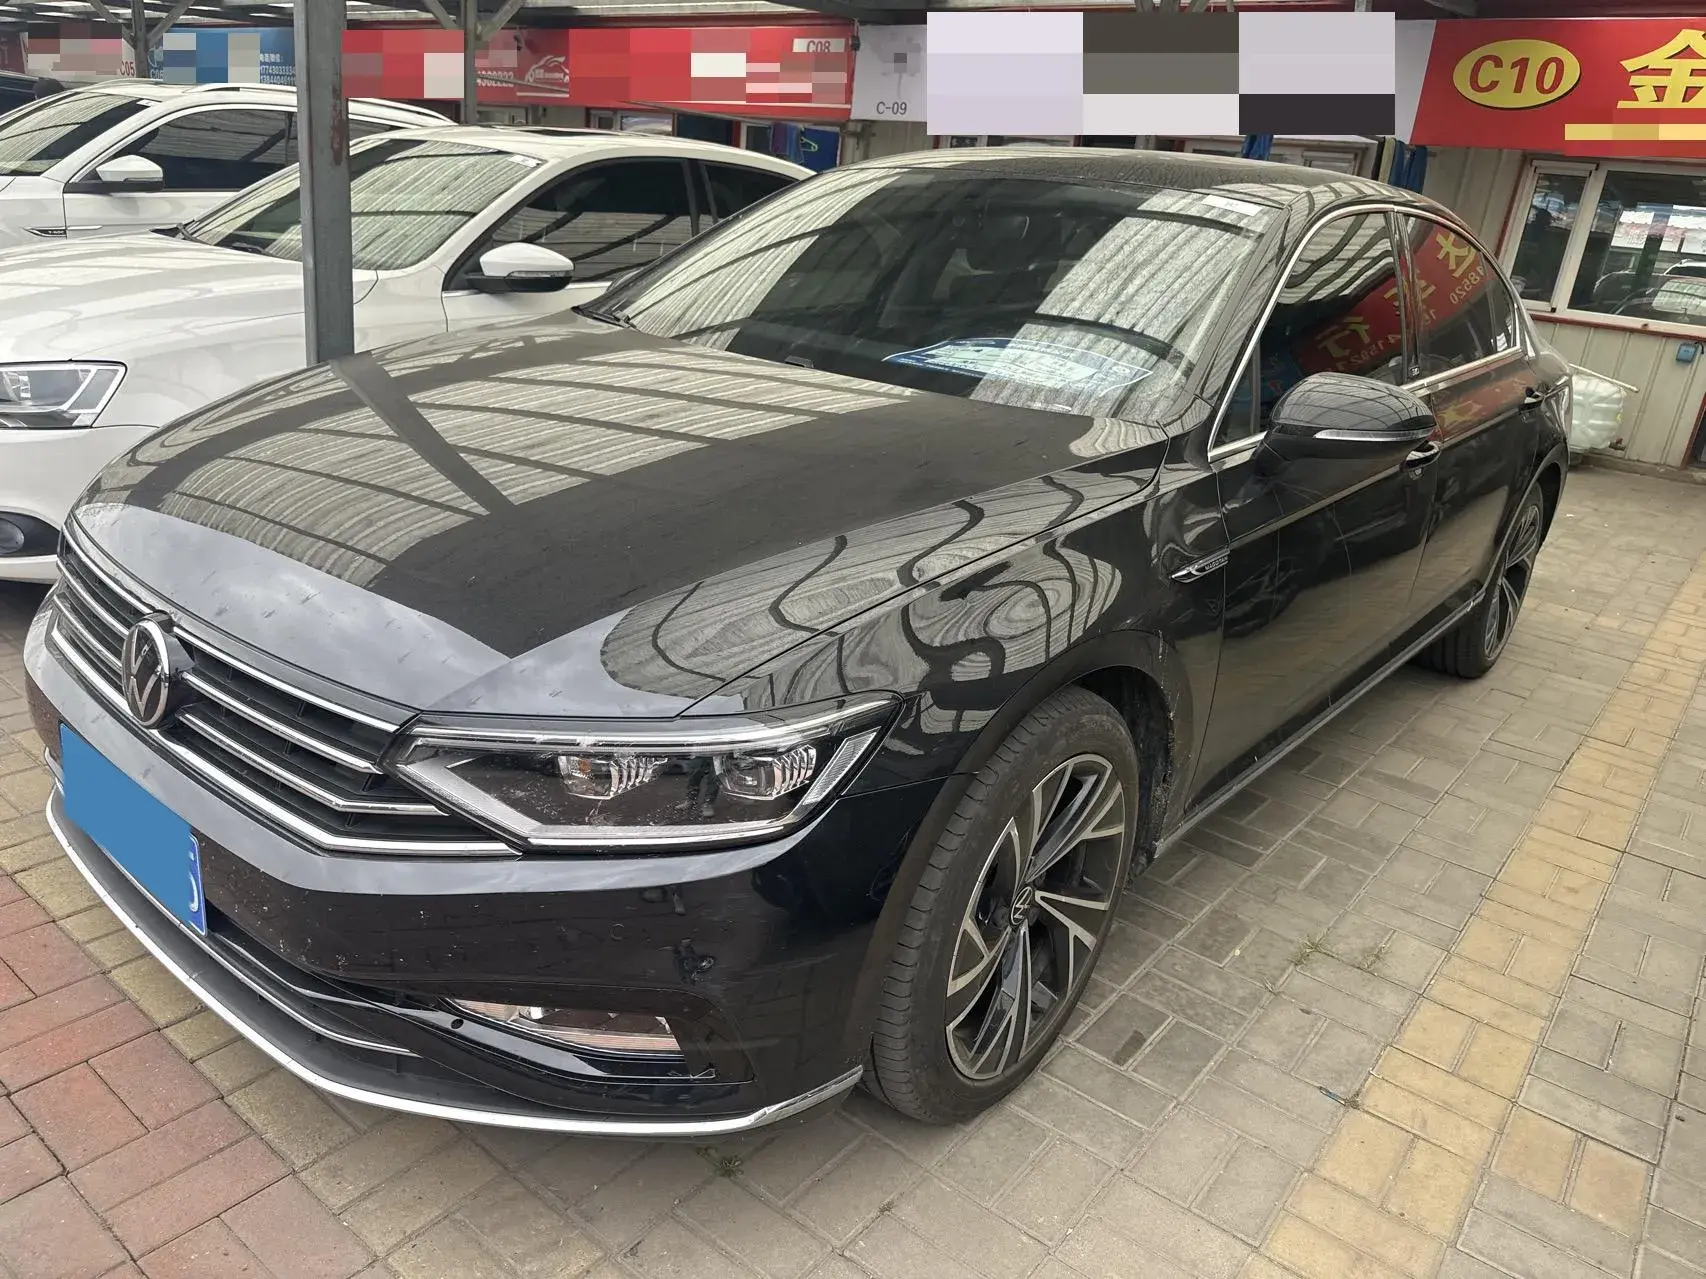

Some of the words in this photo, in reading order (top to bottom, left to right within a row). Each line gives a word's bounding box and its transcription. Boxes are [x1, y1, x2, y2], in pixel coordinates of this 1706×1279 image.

[807, 40, 831, 52] C08
[119, 60, 135, 77] C05
[1469, 54, 1564, 94] C10
[1617, 28, 1706, 109] 金
[876, 101, 908, 116] C-09
